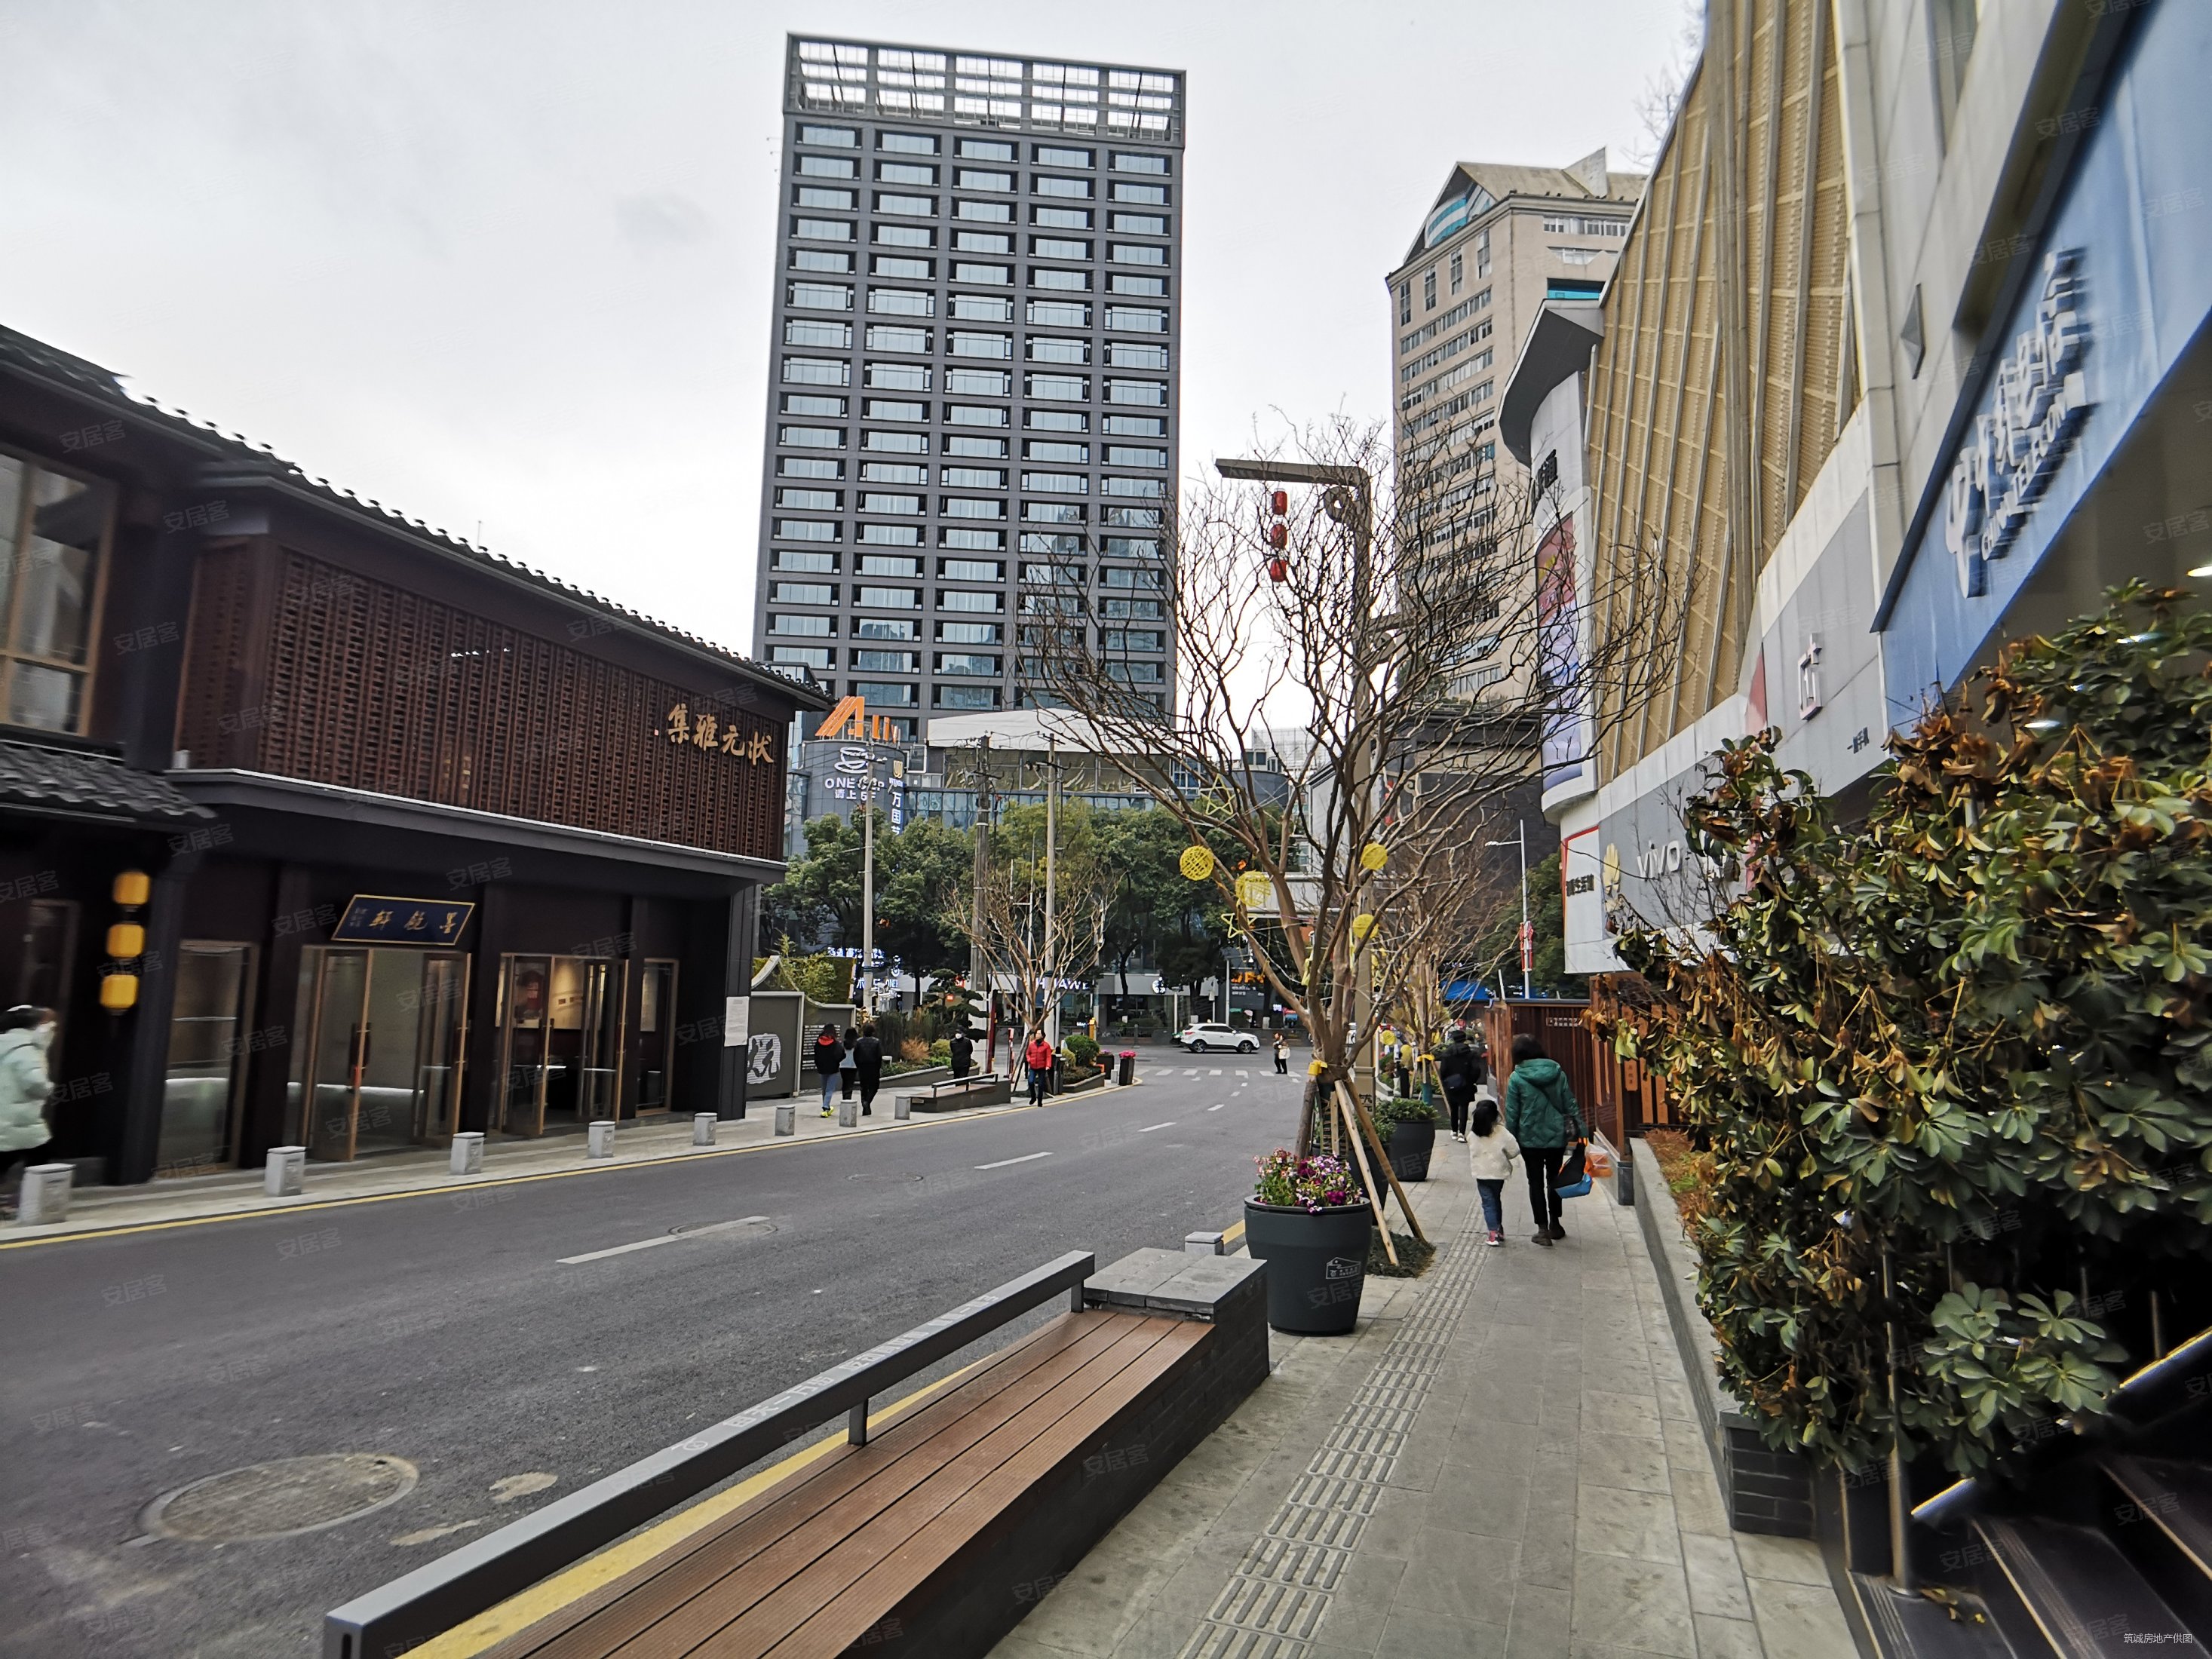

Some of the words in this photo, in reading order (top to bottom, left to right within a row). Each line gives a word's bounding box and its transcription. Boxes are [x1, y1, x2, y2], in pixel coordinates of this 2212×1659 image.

[825, 777, 855, 789] ONE
[857, 777, 885, 791] CP
[1637, 840, 1680, 879] vivo
[1035, 977, 1094, 989] HAWE
